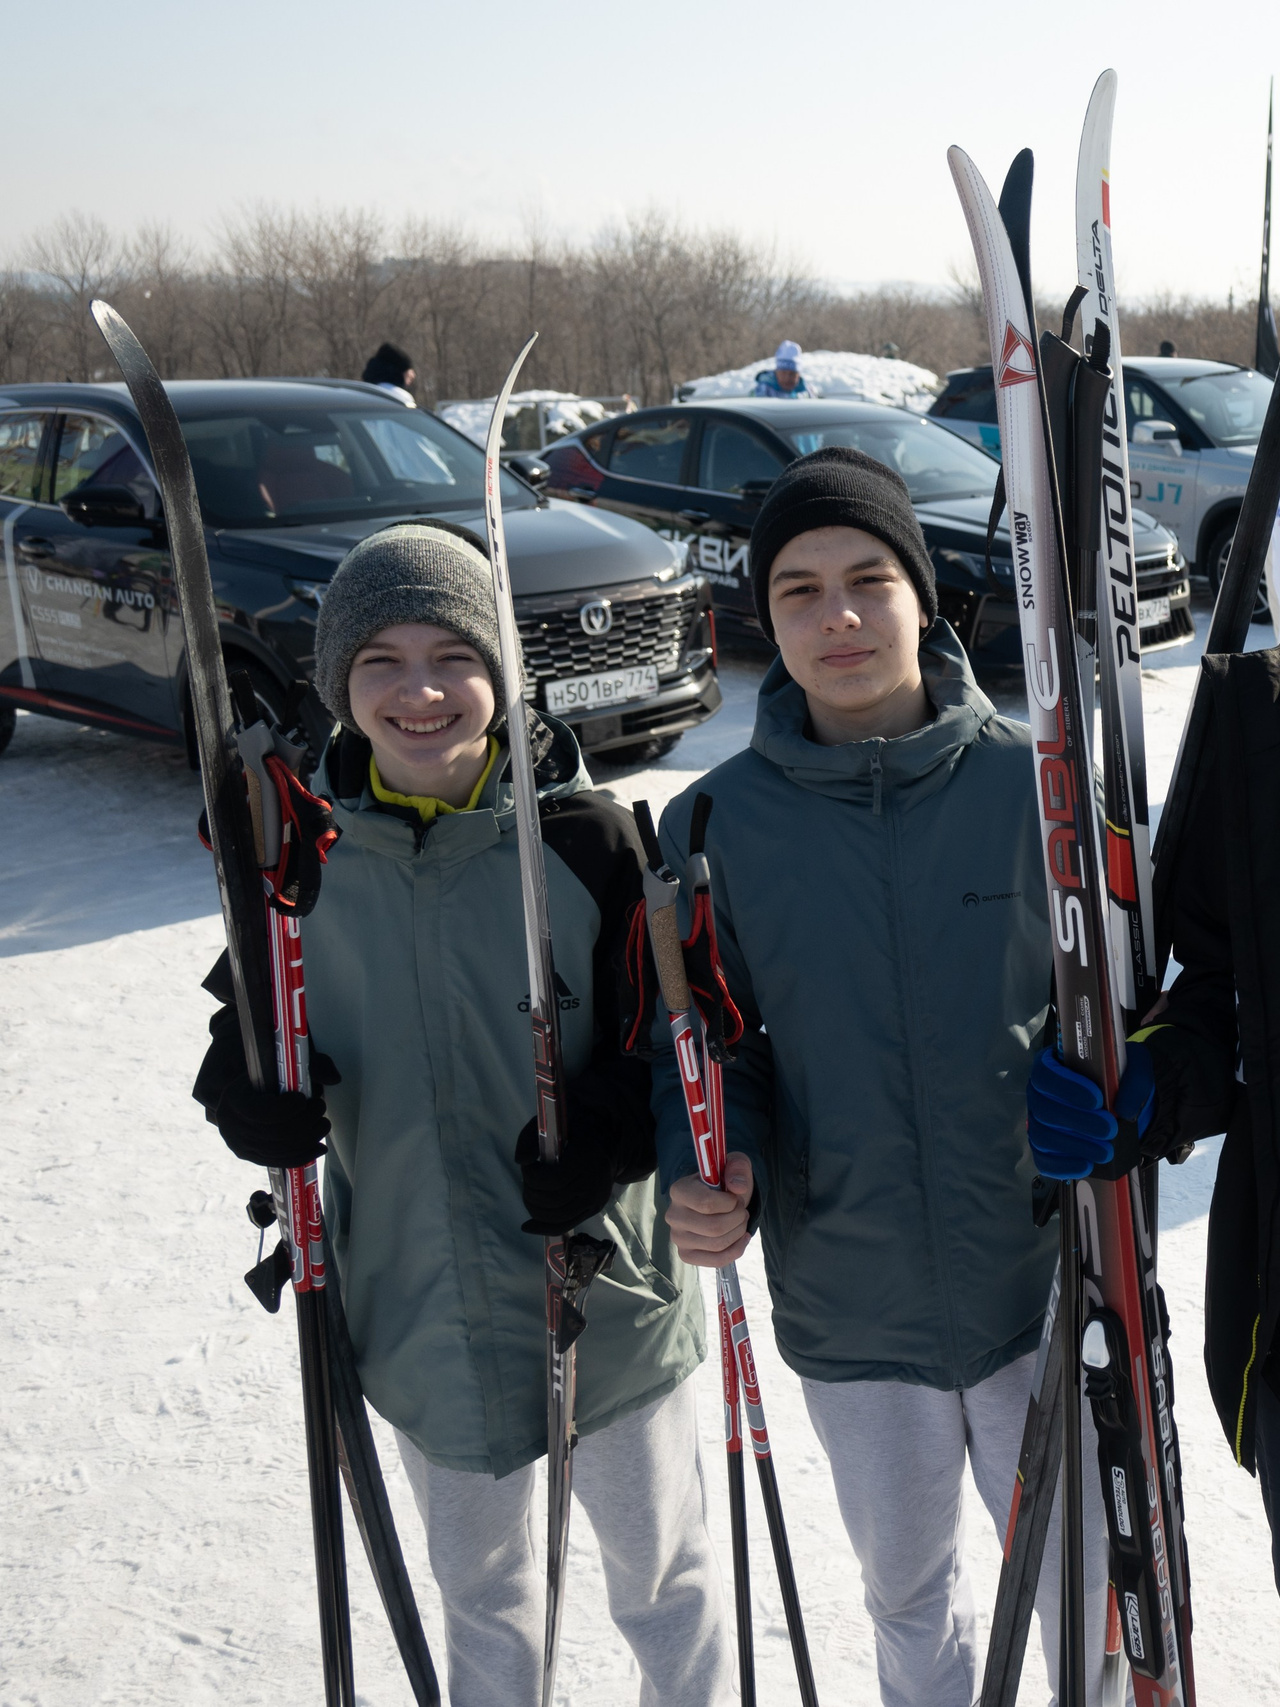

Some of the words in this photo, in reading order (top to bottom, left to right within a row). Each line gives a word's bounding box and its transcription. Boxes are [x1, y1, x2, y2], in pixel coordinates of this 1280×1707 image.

[1091, 218, 1109, 316] DELTA
[45, 575, 112, 601] CHANGAN
[115, 588, 155, 609] AUTO
[627, 668, 654, 686] 774
[1066, 731, 1074, 747] OF
[1027, 627, 1088, 968] SABLE
[1131, 910, 1144, 988] CLASSIC
[1151, 1343, 1176, 1502] SABLE
[1146, 1467, 1171, 1621] SABLE
[1130, 1615, 1142, 1658] Larsen
